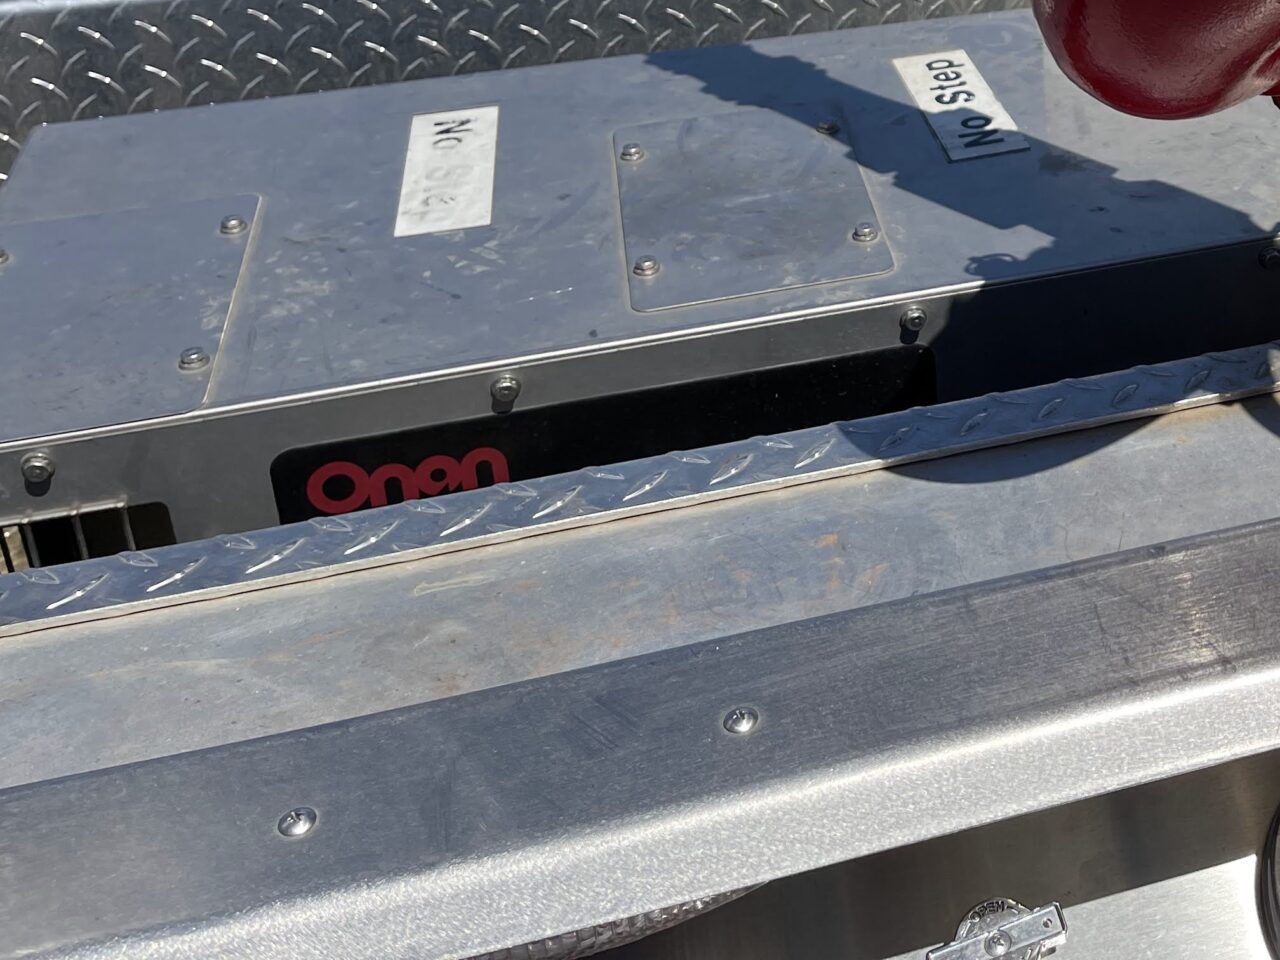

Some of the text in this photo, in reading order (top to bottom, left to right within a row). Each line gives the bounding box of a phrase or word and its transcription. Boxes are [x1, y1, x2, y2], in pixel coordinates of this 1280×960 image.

[926, 59, 1005, 149] No Step
[306, 446, 510, 514] Onan
[968, 900, 1006, 922] OPEN
